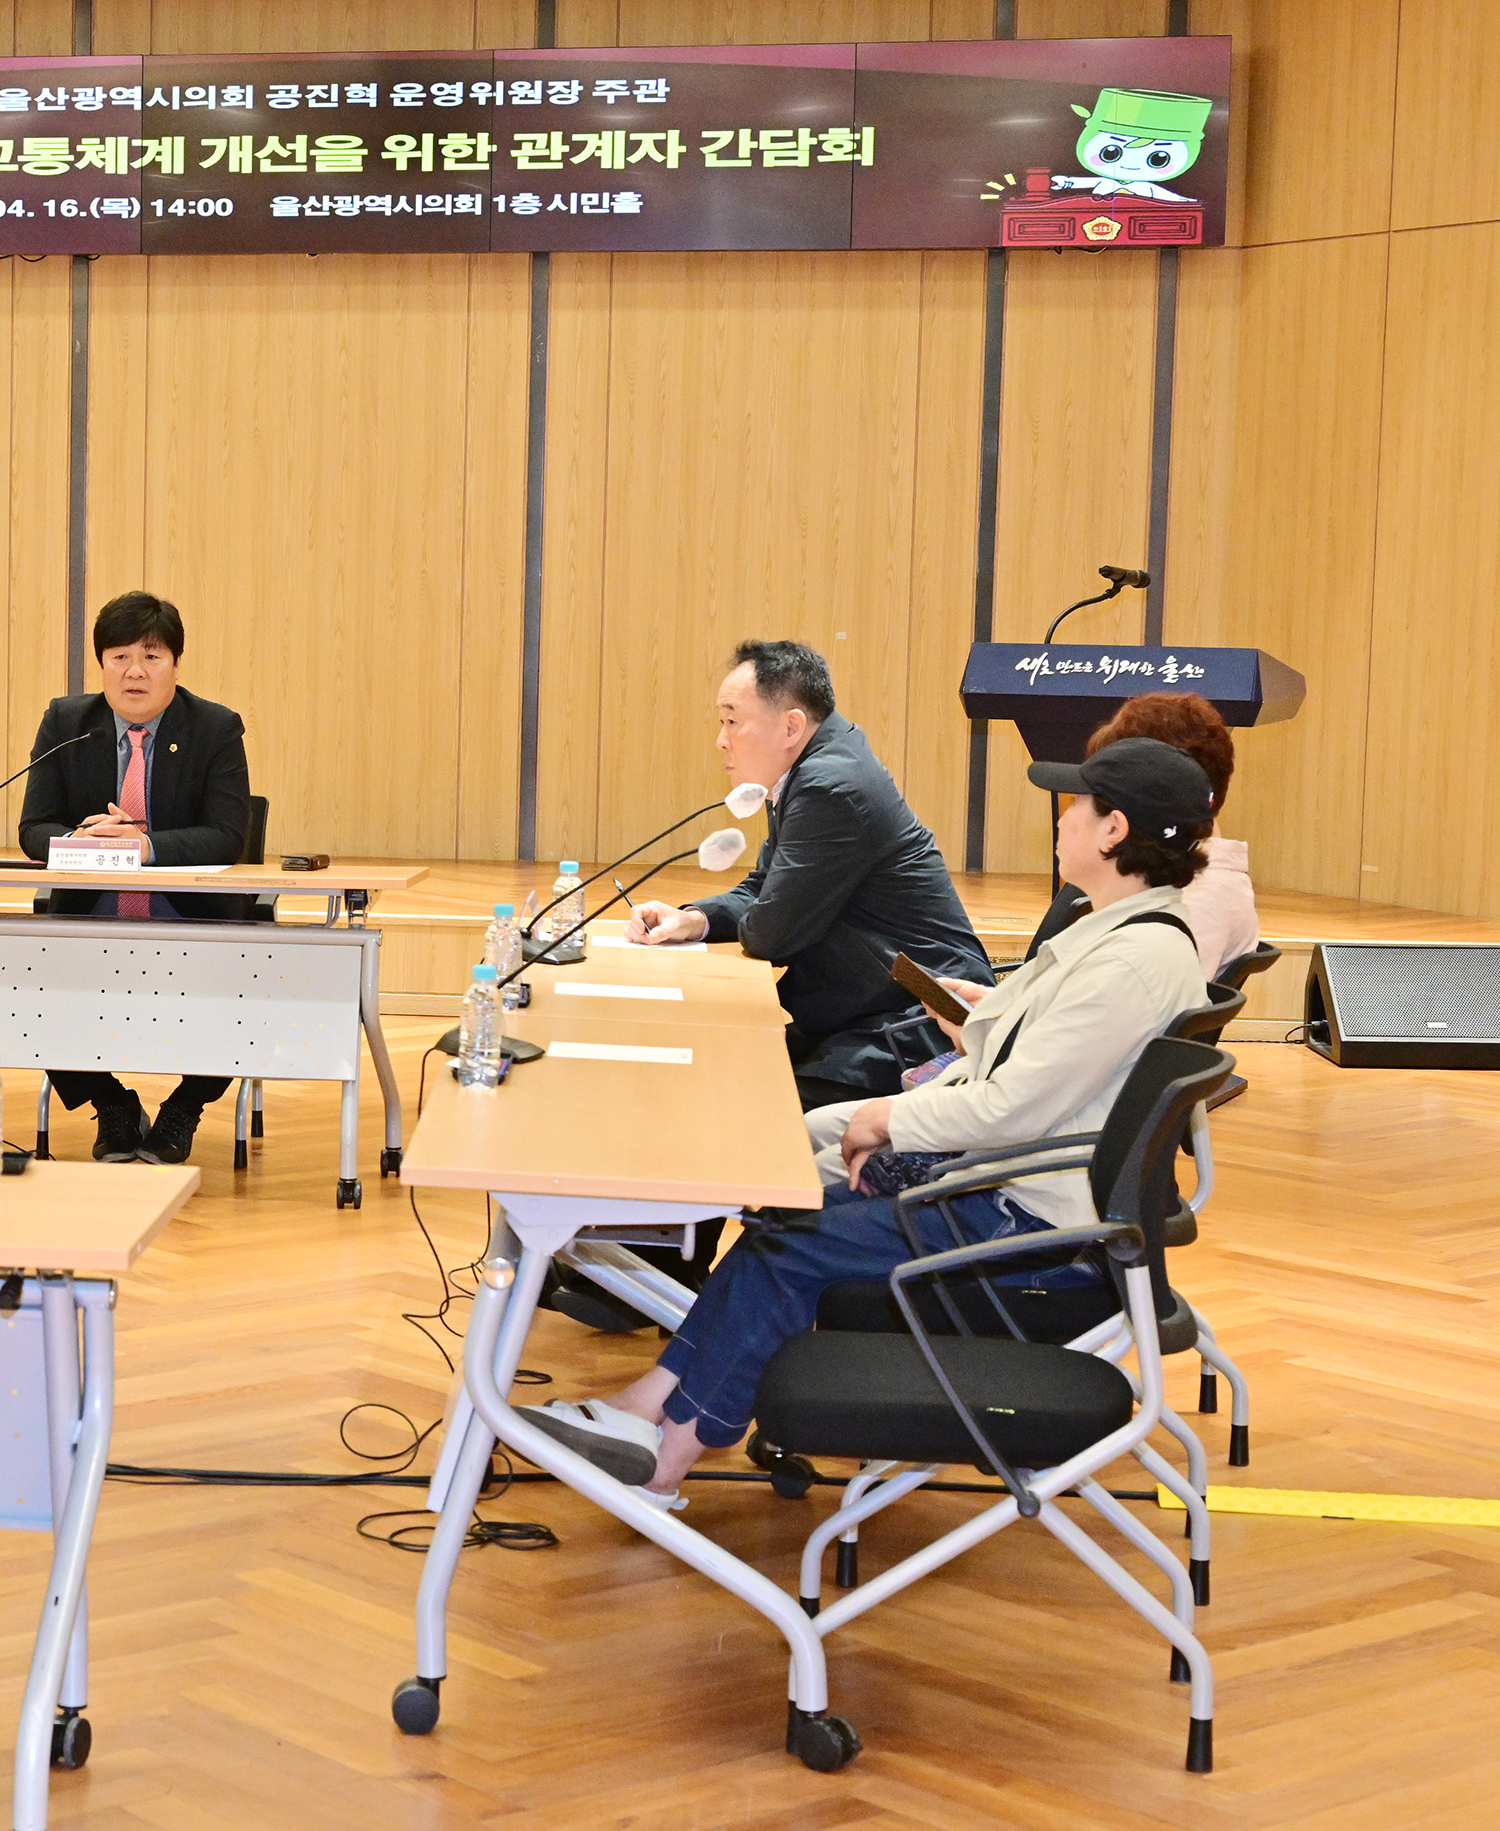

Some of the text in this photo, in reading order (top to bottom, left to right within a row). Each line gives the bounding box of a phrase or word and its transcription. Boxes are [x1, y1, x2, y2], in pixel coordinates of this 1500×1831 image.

[266, 83, 378, 109] 공진혁
[390, 79, 584, 108] 운영위원장
[593, 78, 671, 104] 주관
[199, 134, 369, 174] 개선을
[381, 132, 498, 172] 위한
[511, 129, 687, 170] 관계자
[700, 126, 875, 168] 간담회
[42, 197, 141, 219] 16.(목)
[150, 198, 234, 217] 14:00
[270, 193, 482, 217] 울산광역시의회
[493, 194, 543, 216] 1층
[547, 191, 644, 215] 시민홀
[1056, 660, 1094, 674] 만드는
[1096, 655, 1155, 685] 위대한
[1158, 655, 1206, 684] 울산
